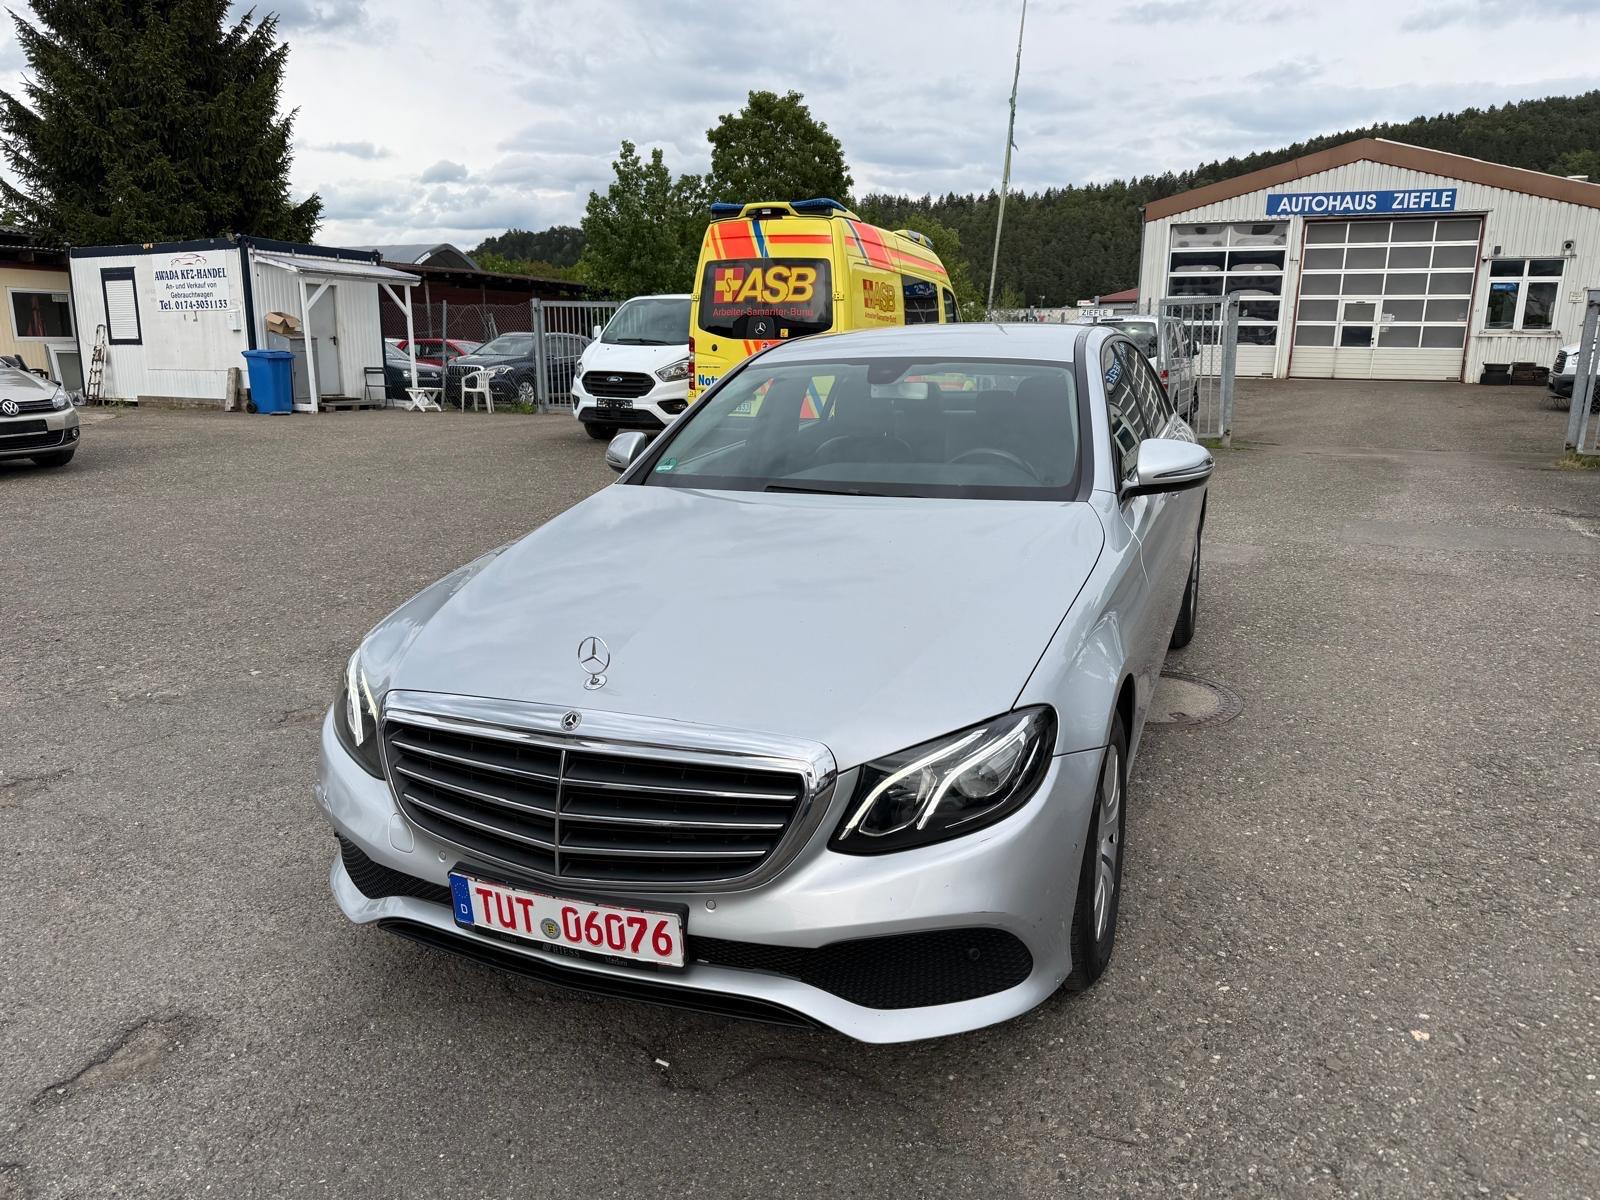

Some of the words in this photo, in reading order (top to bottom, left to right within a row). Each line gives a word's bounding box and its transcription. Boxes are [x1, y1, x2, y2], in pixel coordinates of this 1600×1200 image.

[1277, 194, 1377, 212] AUTOHAUS
[1391, 191, 1452, 209] ZIEFLE
[155, 270, 179, 281] AWADA
[180, 267, 227, 280] KFZ-HANDEL
[187, 281, 206, 289] Verkauf
[734, 265, 817, 304] ASB
[170, 291, 214, 299] Gebrauchtwagen
[873, 282, 896, 312] ASB
[160, 300, 174, 310] Tel.
[698, 374, 718, 386] Not
[461, 903, 468, 914] D
[475, 887, 534, 934] TUT
[561, 906, 673, 957] 06076
